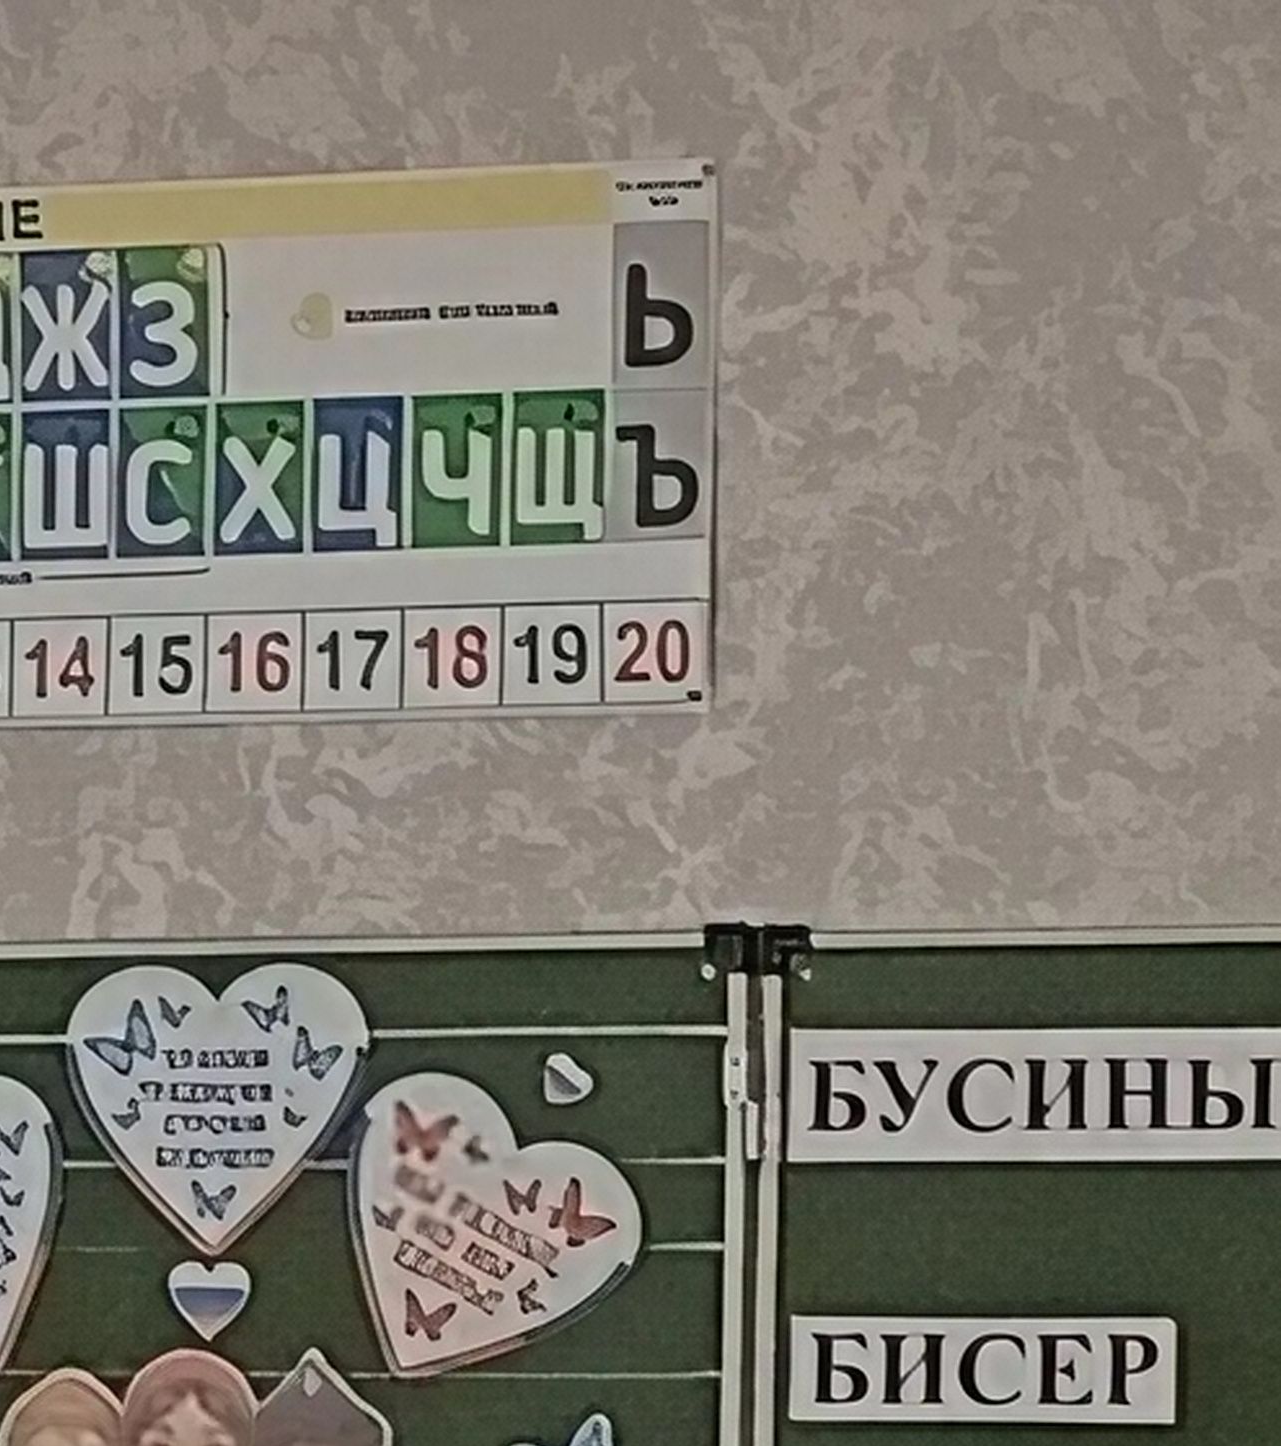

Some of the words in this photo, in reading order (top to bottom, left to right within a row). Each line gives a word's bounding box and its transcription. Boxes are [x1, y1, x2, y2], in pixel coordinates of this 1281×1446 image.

[625, 263, 694, 367] Ь
[616, 424, 699, 527] Ъ
[26, 635, 95, 697] 14
[120, 633, 193, 697] 15
[218, 631, 290, 692] 16
[317, 630, 389, 690] 17
[415, 624, 488, 690] 18
[513, 624, 588, 684] 19
[614, 619, 690, 683] 20
[807, 1058, 1281, 1133] БУСИНЫ
[810, 1333, 1159, 1405] БИСЕР
